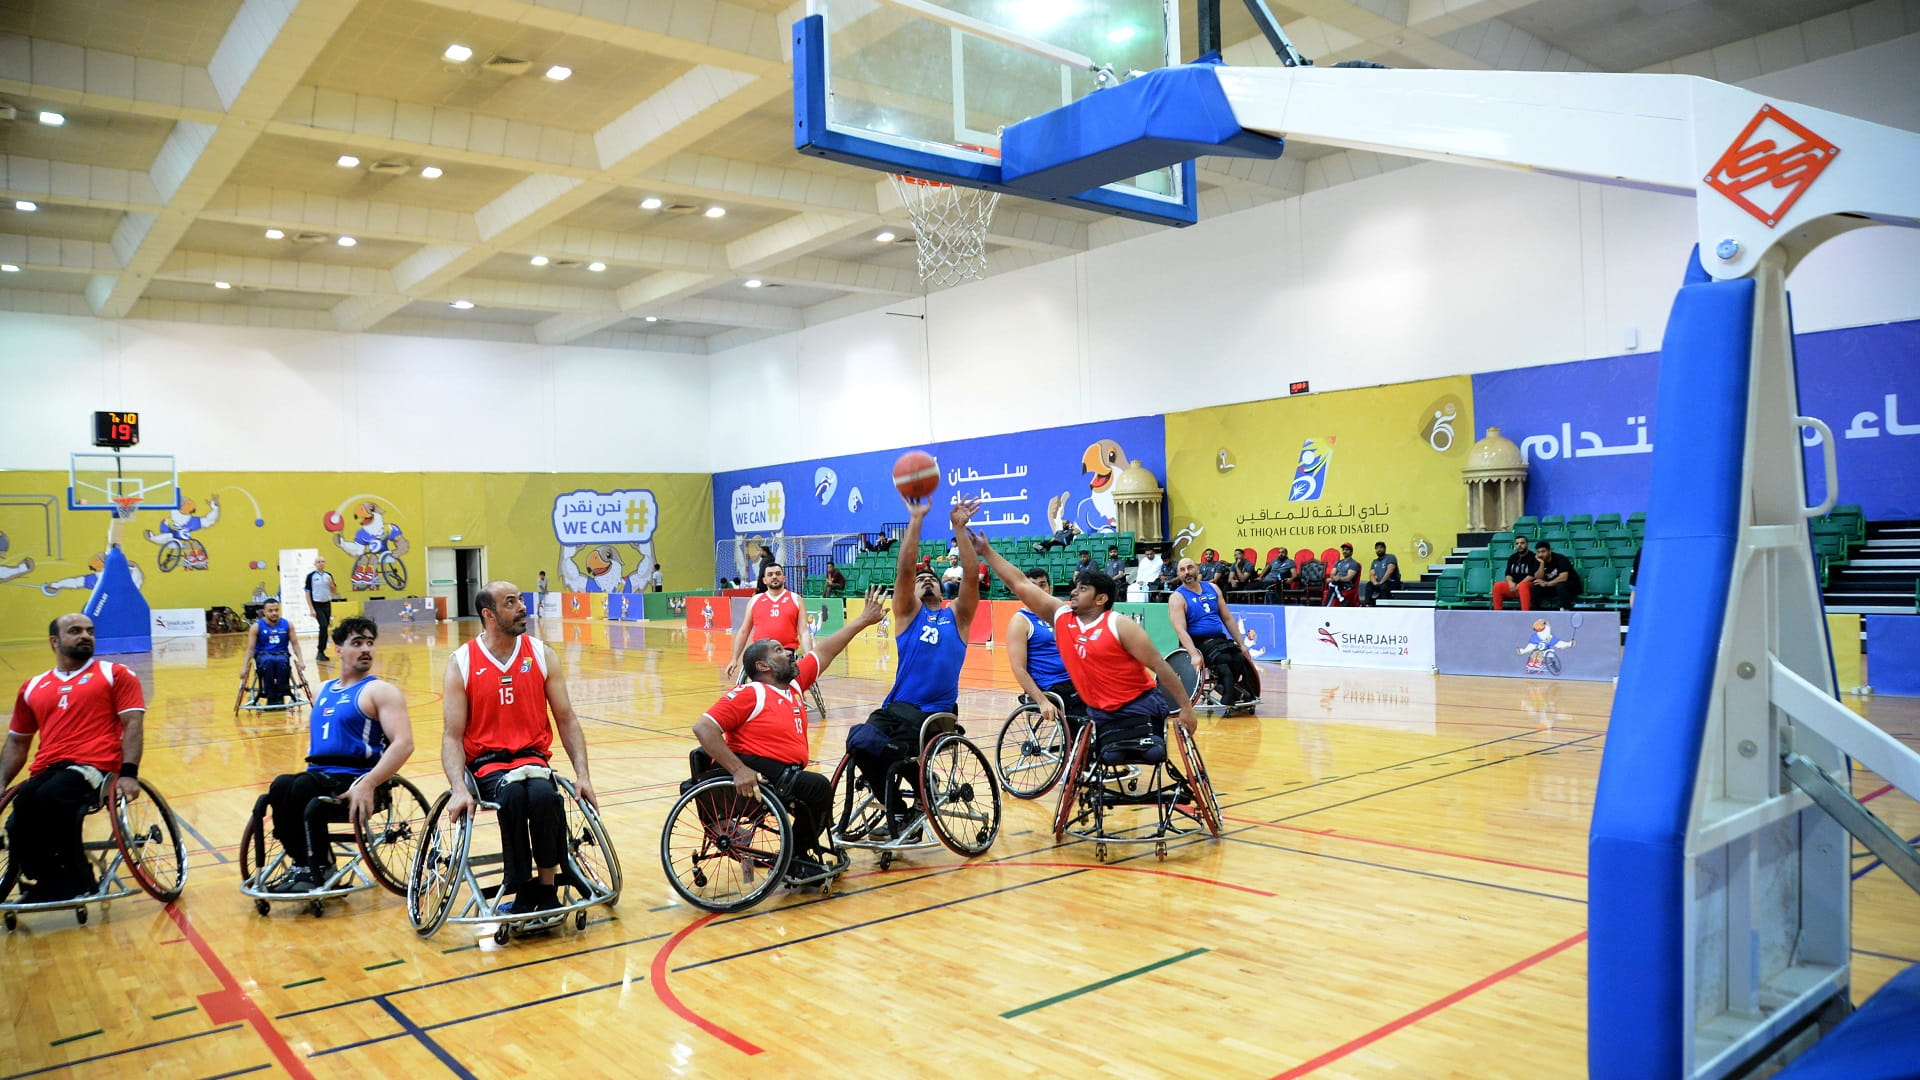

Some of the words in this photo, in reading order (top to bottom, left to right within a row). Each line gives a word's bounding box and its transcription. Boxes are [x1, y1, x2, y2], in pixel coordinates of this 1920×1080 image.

[112, 424, 131, 440] 19
[948, 463, 1028, 486] سلطان
[562, 500, 592, 517] نقدر
[596, 500, 621, 516] نحن
[1237, 507, 1310, 524] للمعاقين
[1312, 503, 1355, 518] الثقة
[1358, 502, 1389, 522] نادي
[736, 512, 748, 525] WE
[750, 510, 766, 524] CAN
[563, 521, 587, 534] WE
[591, 520, 622, 534] CAN
[1237, 528, 1247, 537] AL
[1250, 526, 1287, 538] THIQAH
[1289, 525, 1314, 536] CLUB
[1317, 524, 1337, 534] FOR
[1340, 523, 1389, 534] DISABLED
[770, 609, 779, 617] 30
[1203, 603, 1211, 613] 3
[920, 625, 938, 644] 23
[1341, 634, 1397, 645] SHARJAH
[1398, 635, 1408, 644] 20
[1398, 647, 1409, 655] 24
[58, 695, 68, 709] 4
[498, 687, 514, 705] 15
[322, 722, 330, 740] 1
[794, 718, 803, 734] 13
